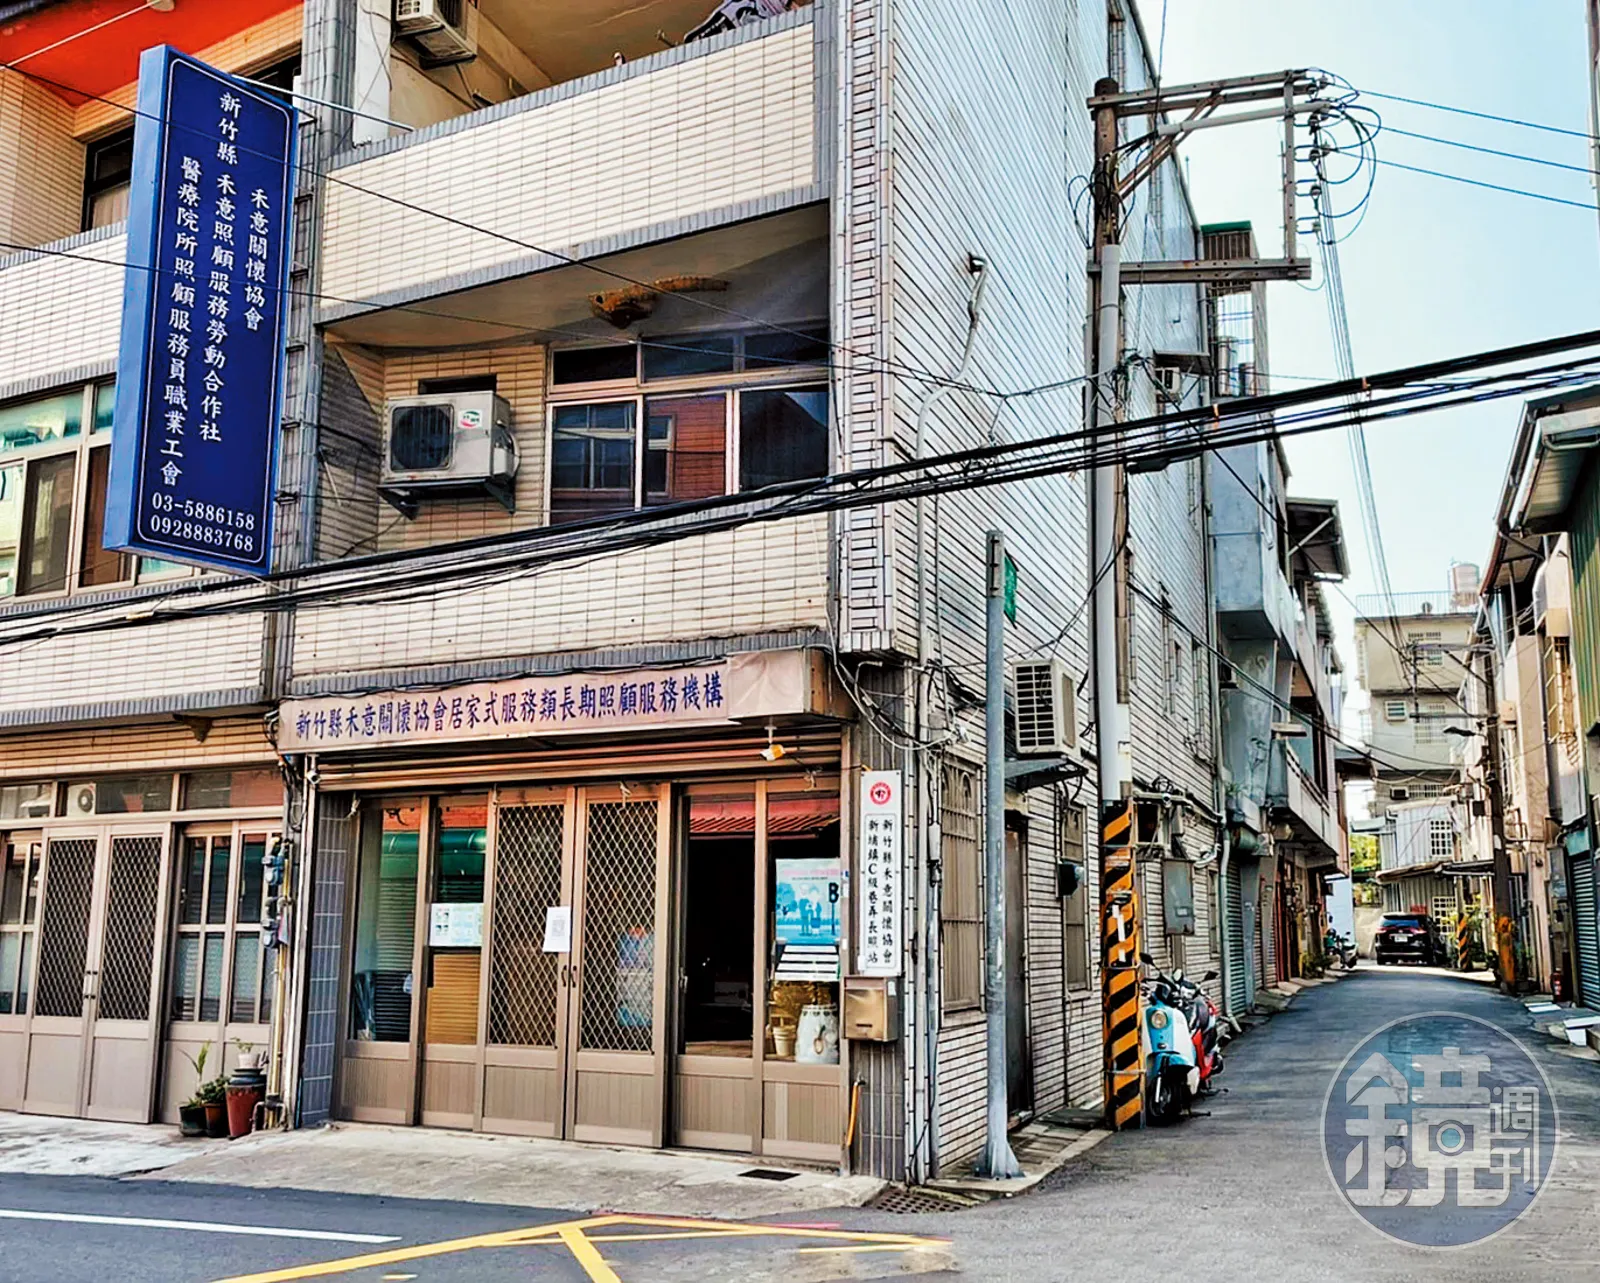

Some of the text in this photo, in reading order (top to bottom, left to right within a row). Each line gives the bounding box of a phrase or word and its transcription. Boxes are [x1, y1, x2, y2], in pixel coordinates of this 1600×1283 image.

[216, 91, 242, 166] 新竹縣
[243, 188, 270, 332] 禾意關懷協會
[160, 155, 203, 487] 醫療院所照顧服務員職業工會
[150, 514, 254, 553] 0928883768
[151, 491, 255, 531] 03-5886158
